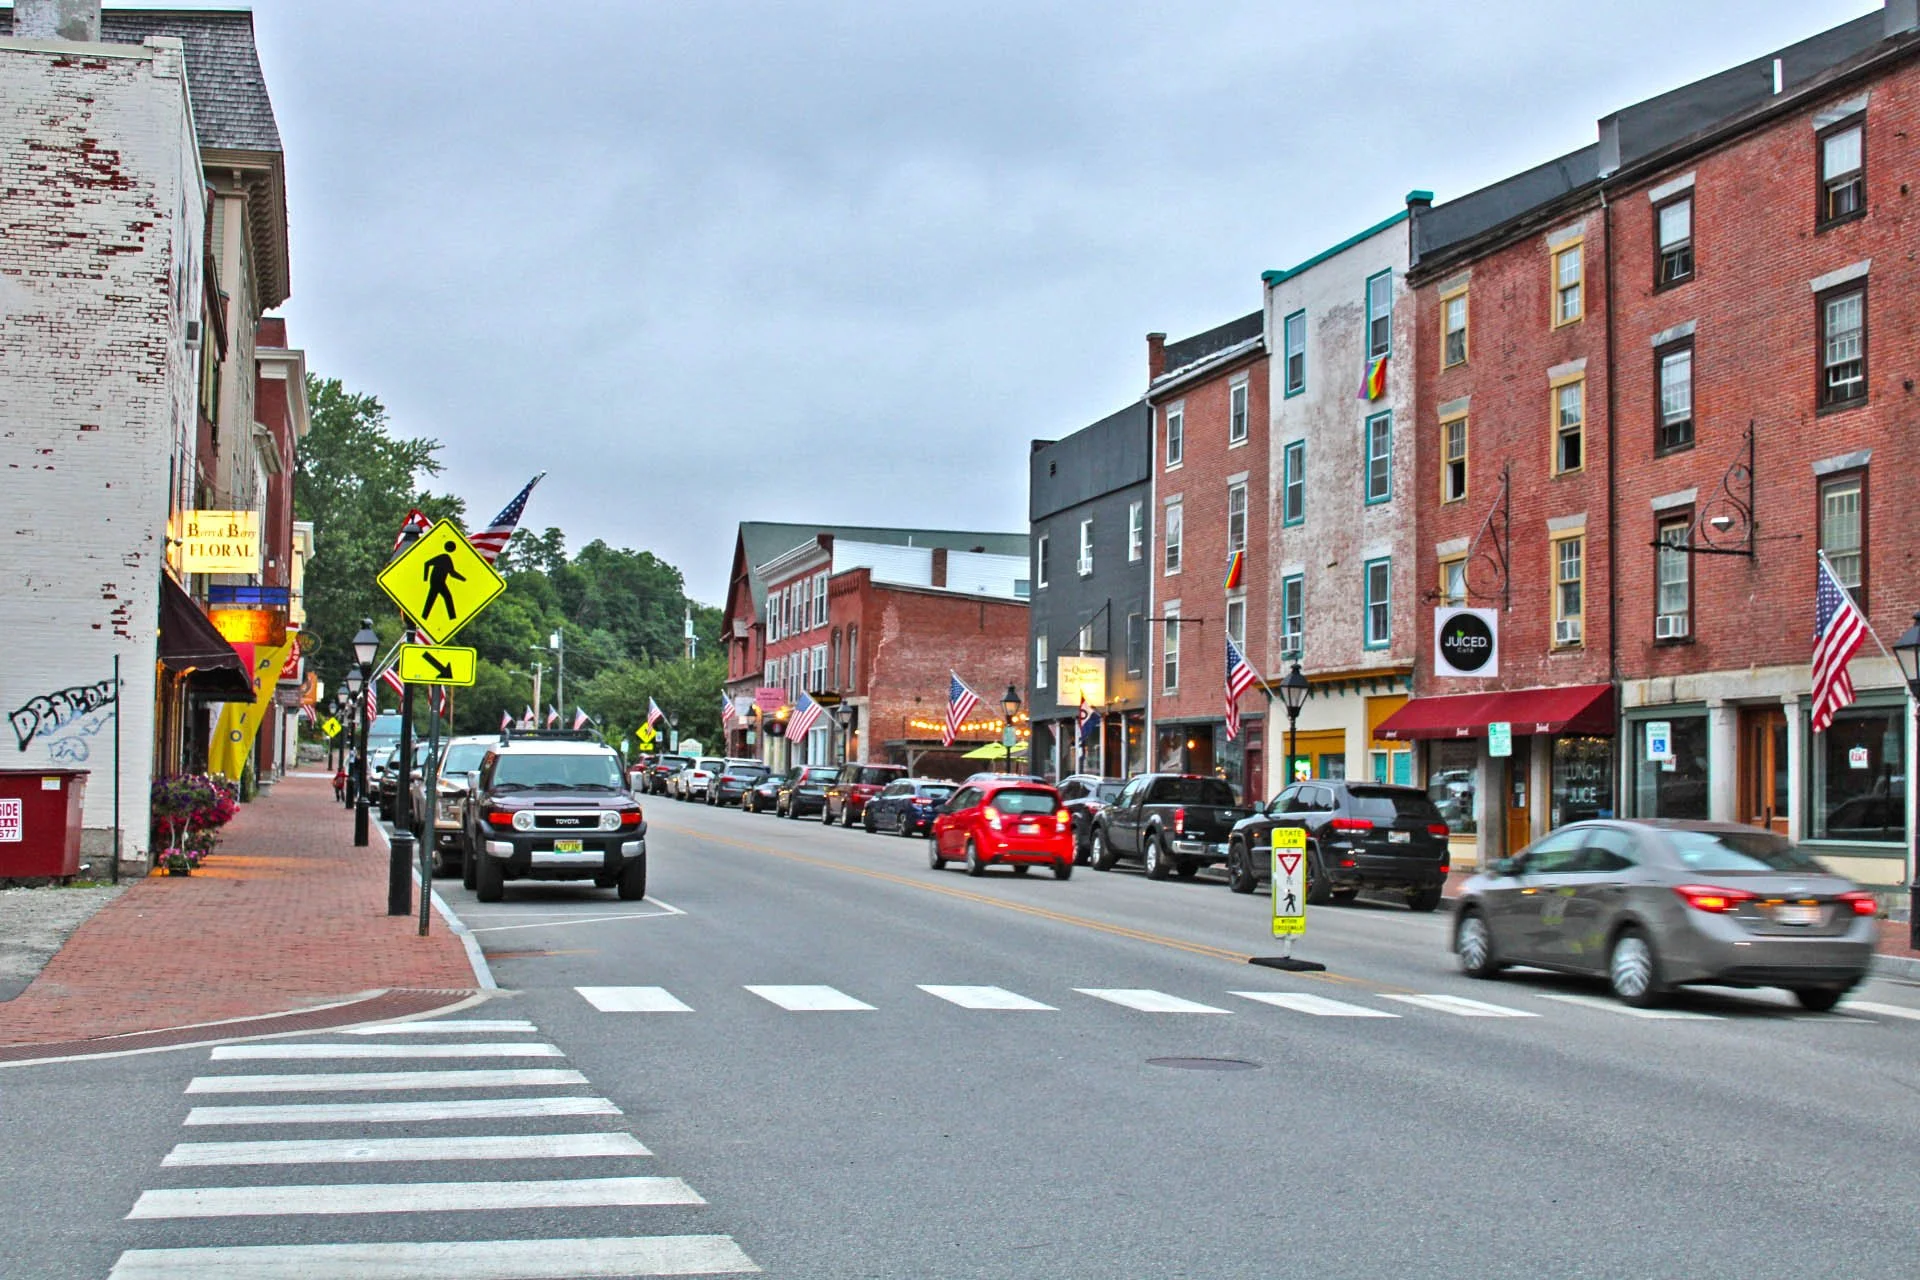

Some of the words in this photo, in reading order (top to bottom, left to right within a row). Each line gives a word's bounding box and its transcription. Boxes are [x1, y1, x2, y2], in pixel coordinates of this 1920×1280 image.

[189, 543, 254, 557] FLORAL
[1445, 635, 1488, 648] JUICED
[1279, 829, 1302, 838] STATE
[1282, 837, 1298, 845] LAW
